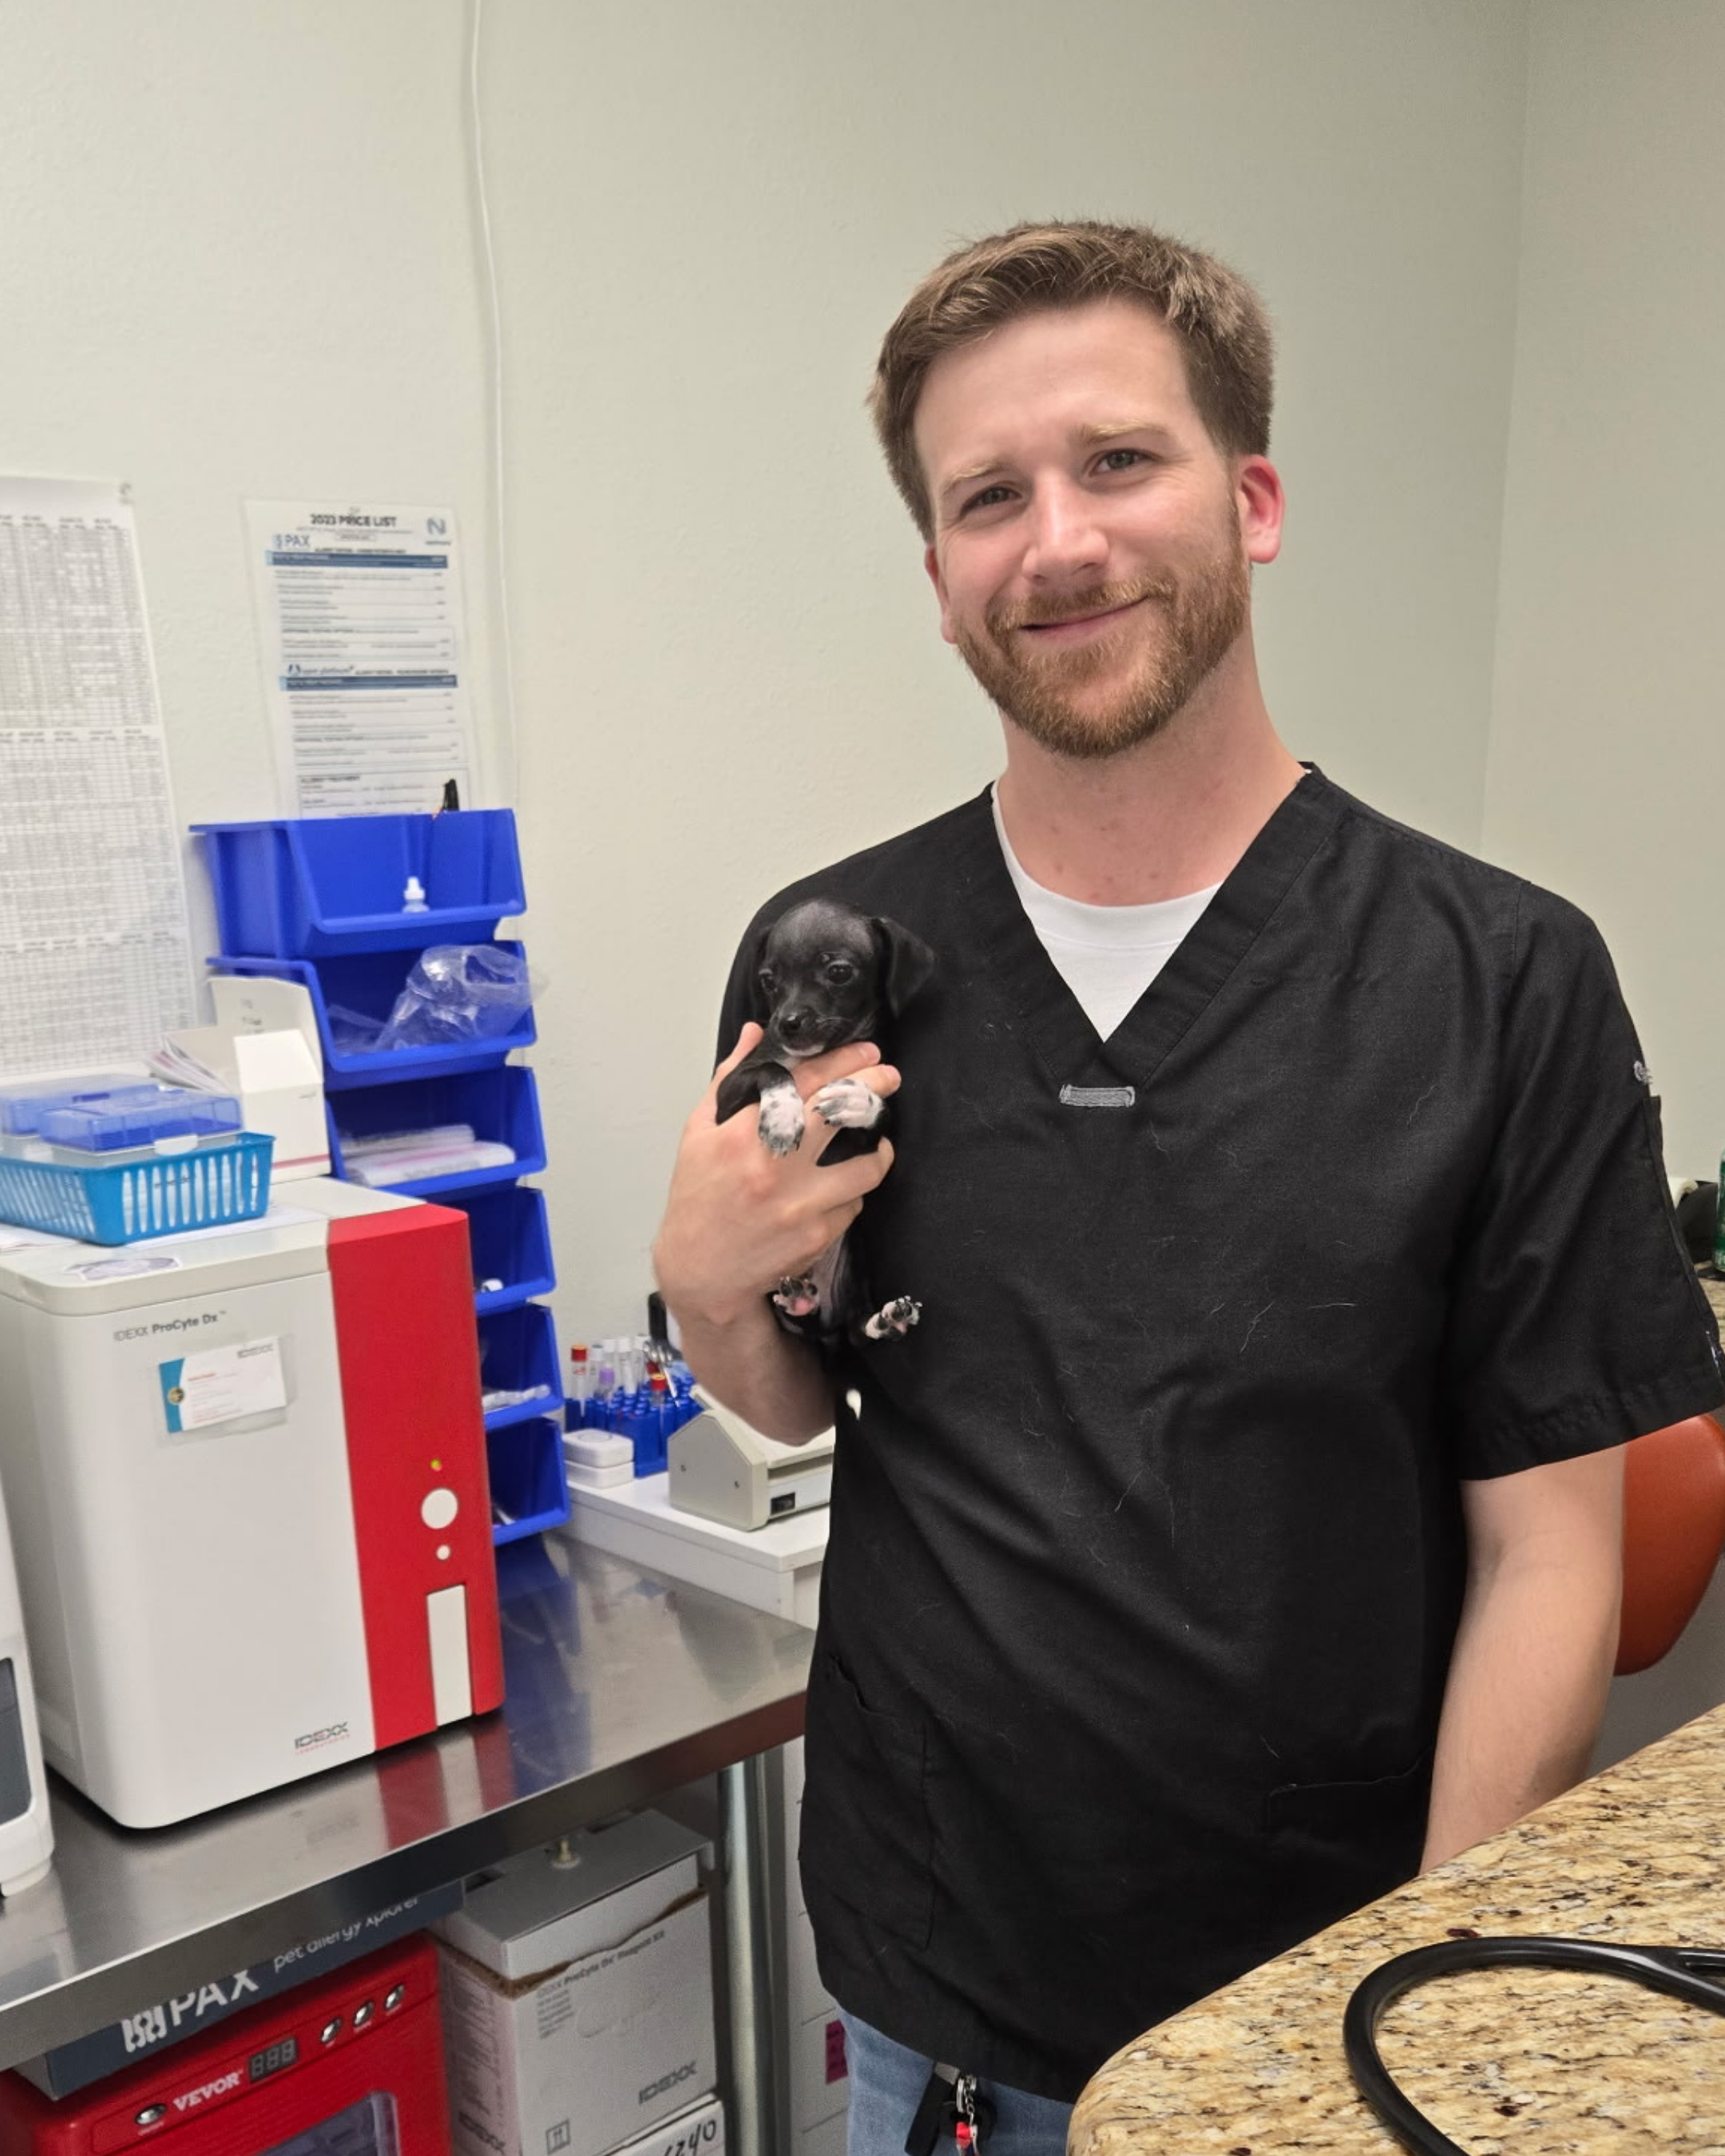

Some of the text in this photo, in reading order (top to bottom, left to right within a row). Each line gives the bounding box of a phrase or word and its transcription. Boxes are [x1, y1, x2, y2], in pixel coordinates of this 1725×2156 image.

[310, 513, 397, 527] 2023 PRICE LIST
[284, 535, 311, 548] PAX
[152, 1318, 199, 1334] ProCyte
[294, 1722, 348, 1749] IDEXX
[273, 1947, 304, 1973] pet
[169, 1969, 260, 2027] PAX
[172, 2071, 240, 2111] VEVOR
[639, 2061, 697, 2104] IDEXX
